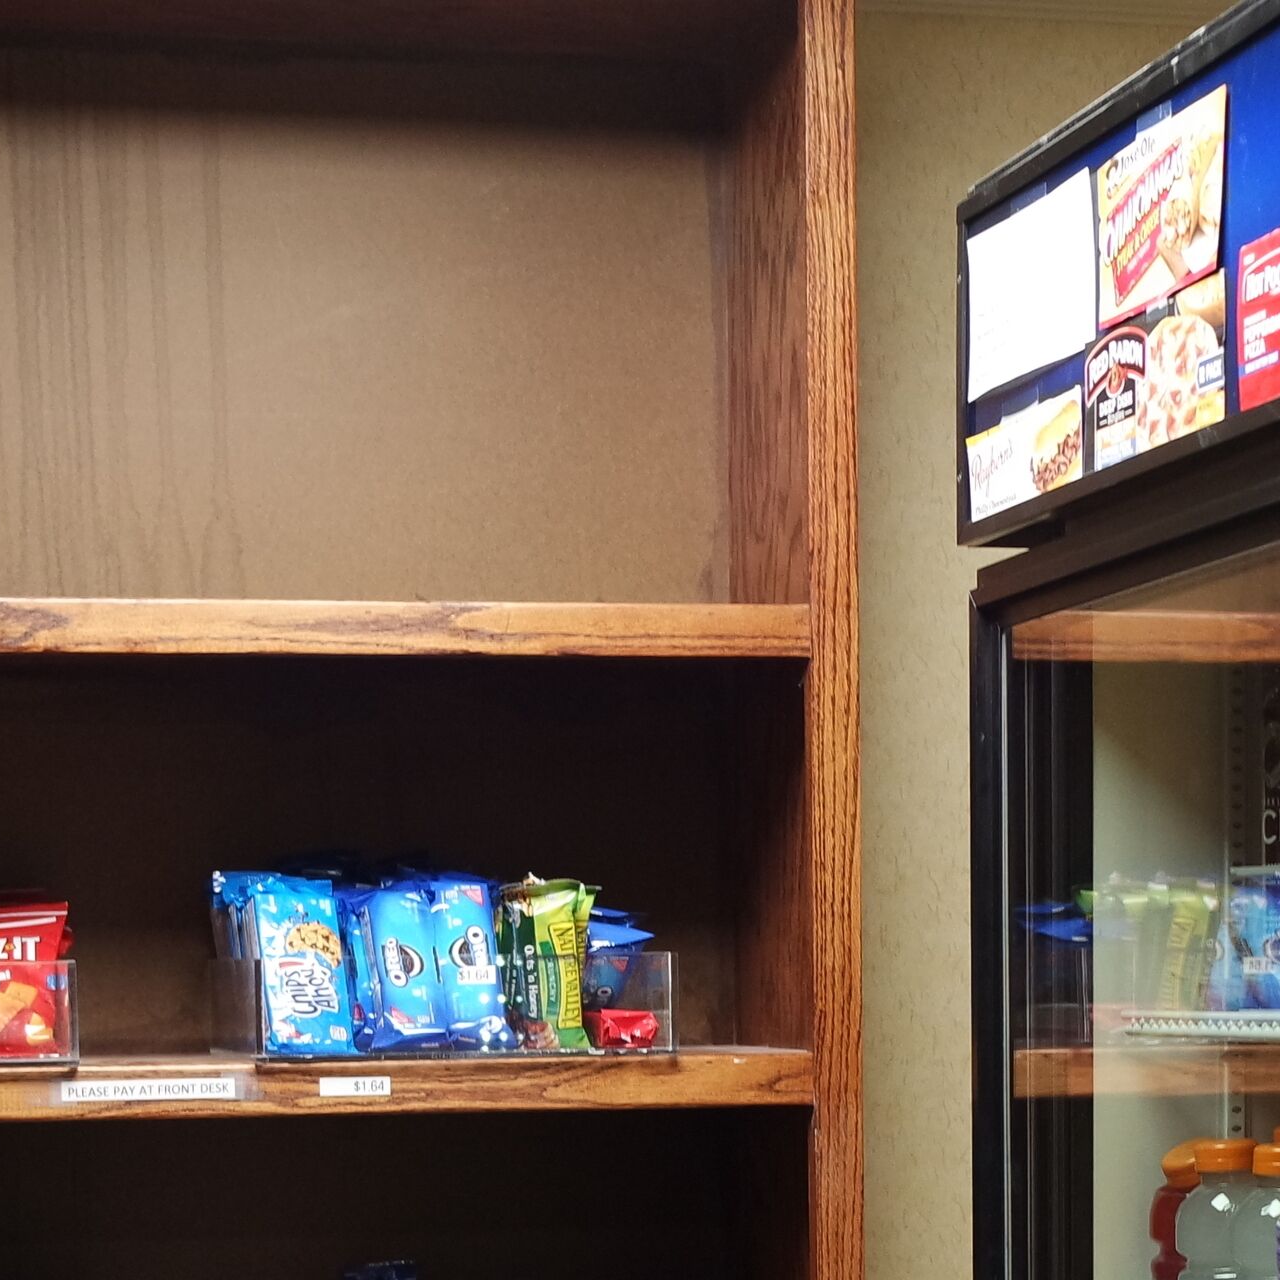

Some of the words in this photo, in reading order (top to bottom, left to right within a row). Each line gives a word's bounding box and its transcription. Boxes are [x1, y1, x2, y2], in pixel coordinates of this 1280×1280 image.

[383, 937, 409, 988] OREO
[458, 967, 490, 981] $1.64
[565, 976, 581, 1027] VALLEY
[68, 1085, 110, 1098] PLEASE
[113, 1084, 136, 1097] PAY
[139, 1083, 155, 1096] AT
[158, 1082, 196, 1096] FRONT
[200, 1081, 230, 1095] DESK
[353, 1079, 385, 1093] $1.64
